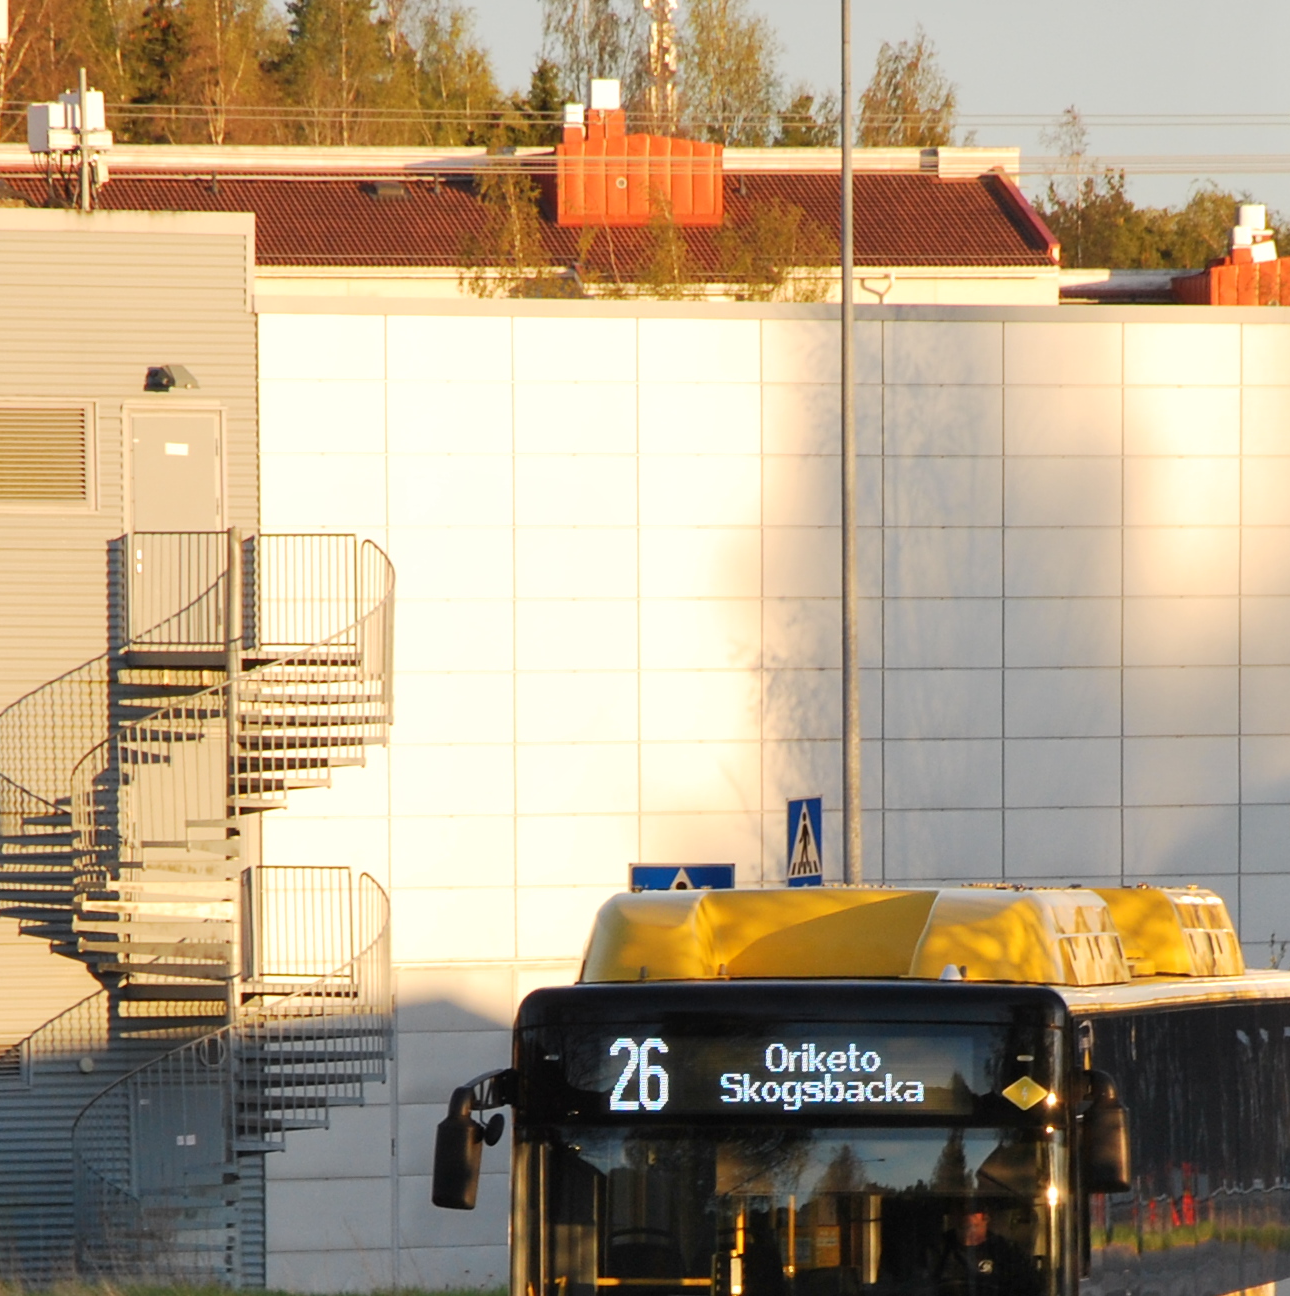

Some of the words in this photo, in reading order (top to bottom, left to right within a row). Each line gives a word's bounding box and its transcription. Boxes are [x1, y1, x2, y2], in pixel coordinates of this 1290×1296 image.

[609, 1037, 669, 1111] 26
[764, 1043, 882, 1073] Oriketo
[719, 1072, 925, 1111] Skogsbacka
